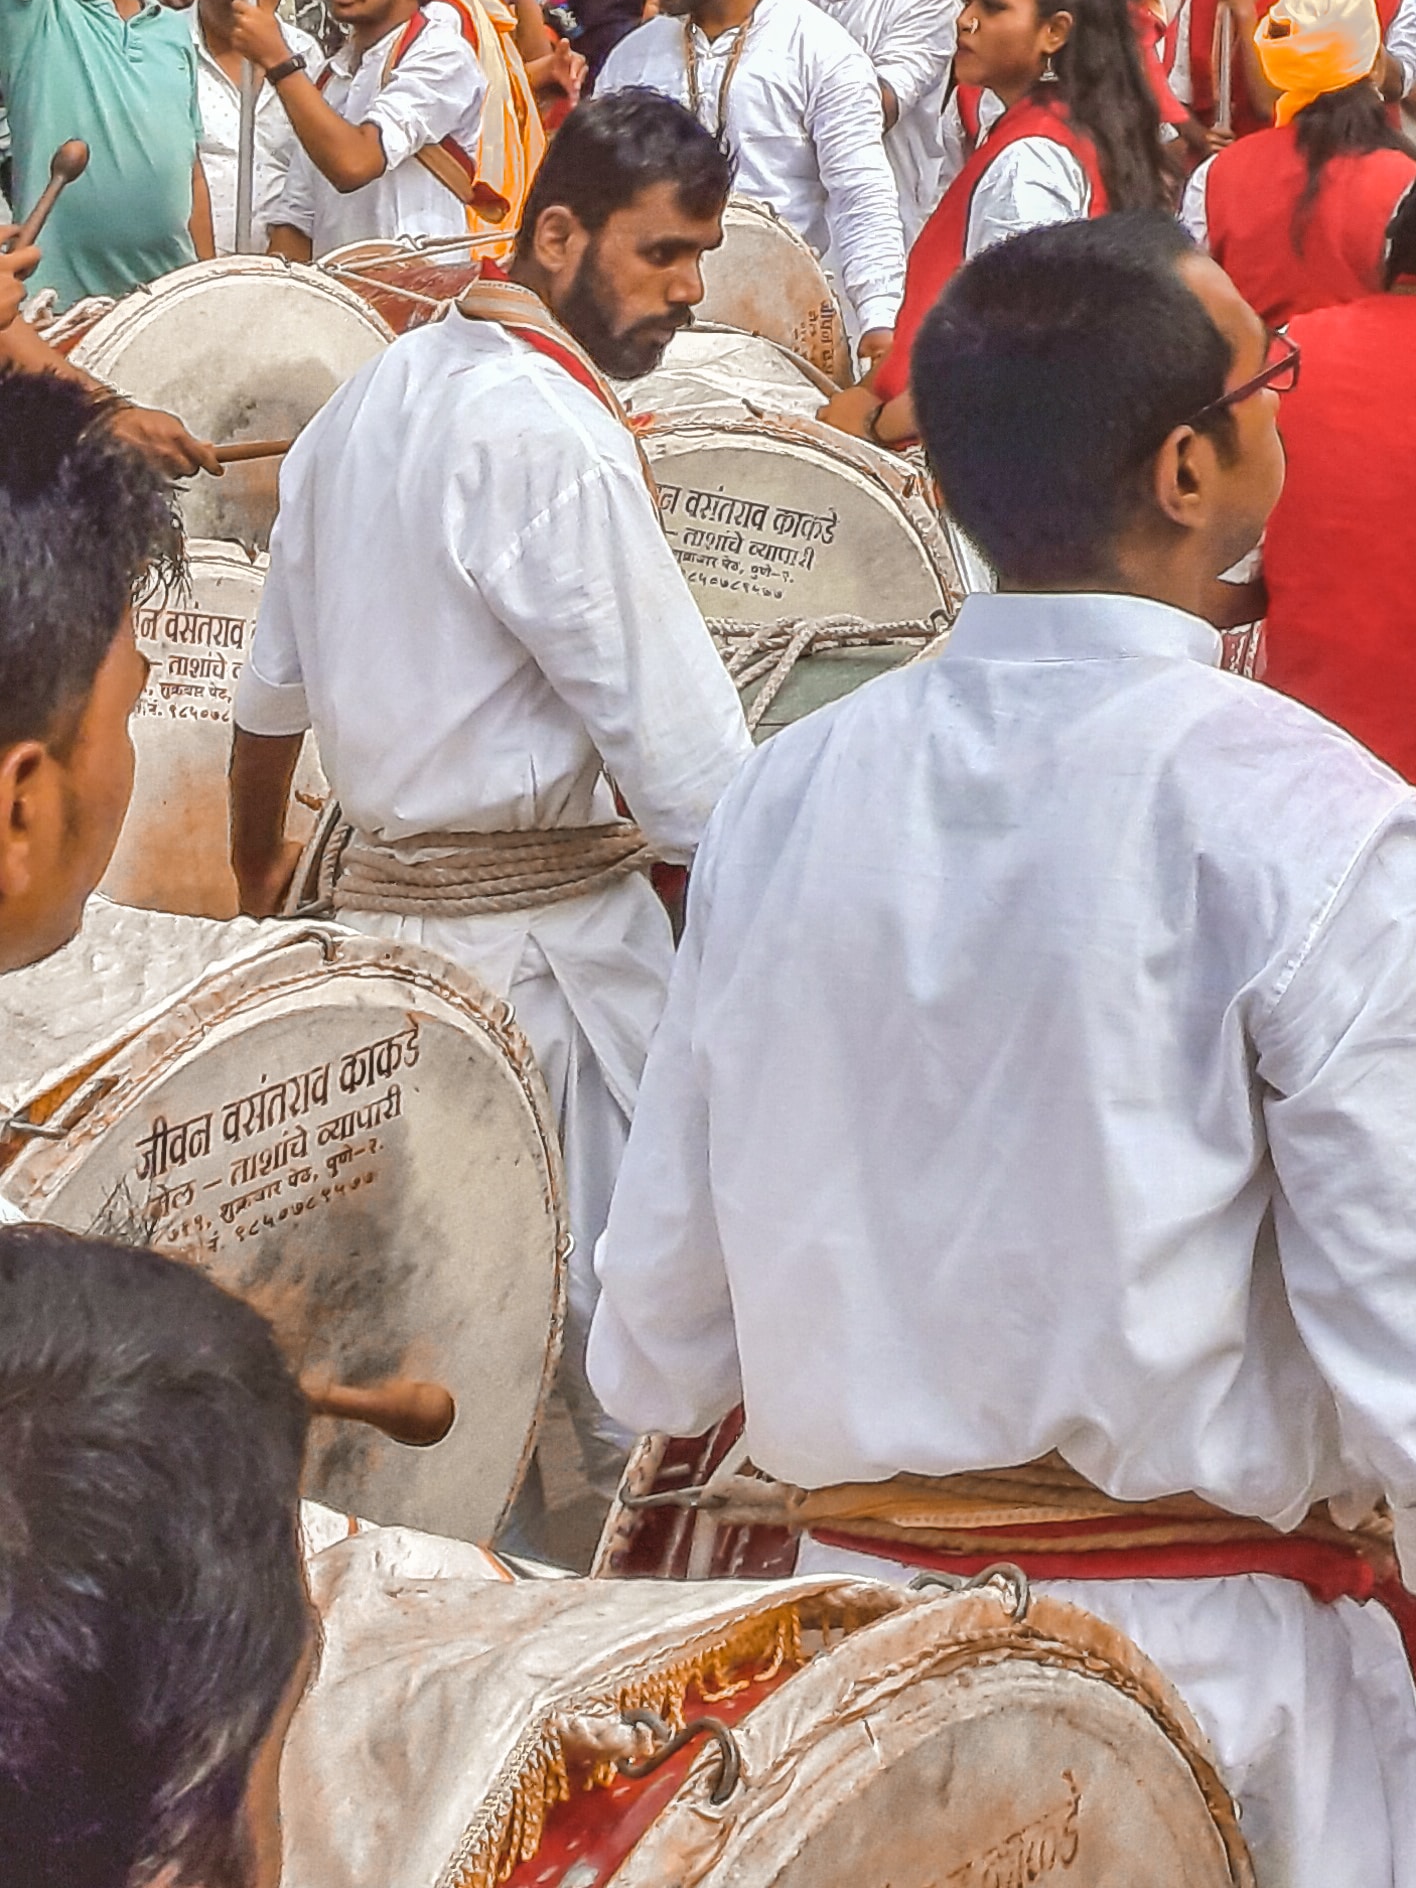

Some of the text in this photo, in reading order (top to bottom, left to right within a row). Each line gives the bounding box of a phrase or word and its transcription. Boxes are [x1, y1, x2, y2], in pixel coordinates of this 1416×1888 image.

[685, 485, 771, 532] वसंतराव
[772, 507, 841, 546] काकडे
[683, 526, 745, 555] ताशांचे
[164, 601, 247, 650] वसंतराव
[168, 651, 227, 680] ताशांचे
[169, 704, 231, 722] ९८५०७८
[135, 1012, 420, 1181] जीवन वसंतराव काकडे
[230, 1125, 309, 1188] ताशांचे
[316, 1083, 403, 1147] व्यापारी
